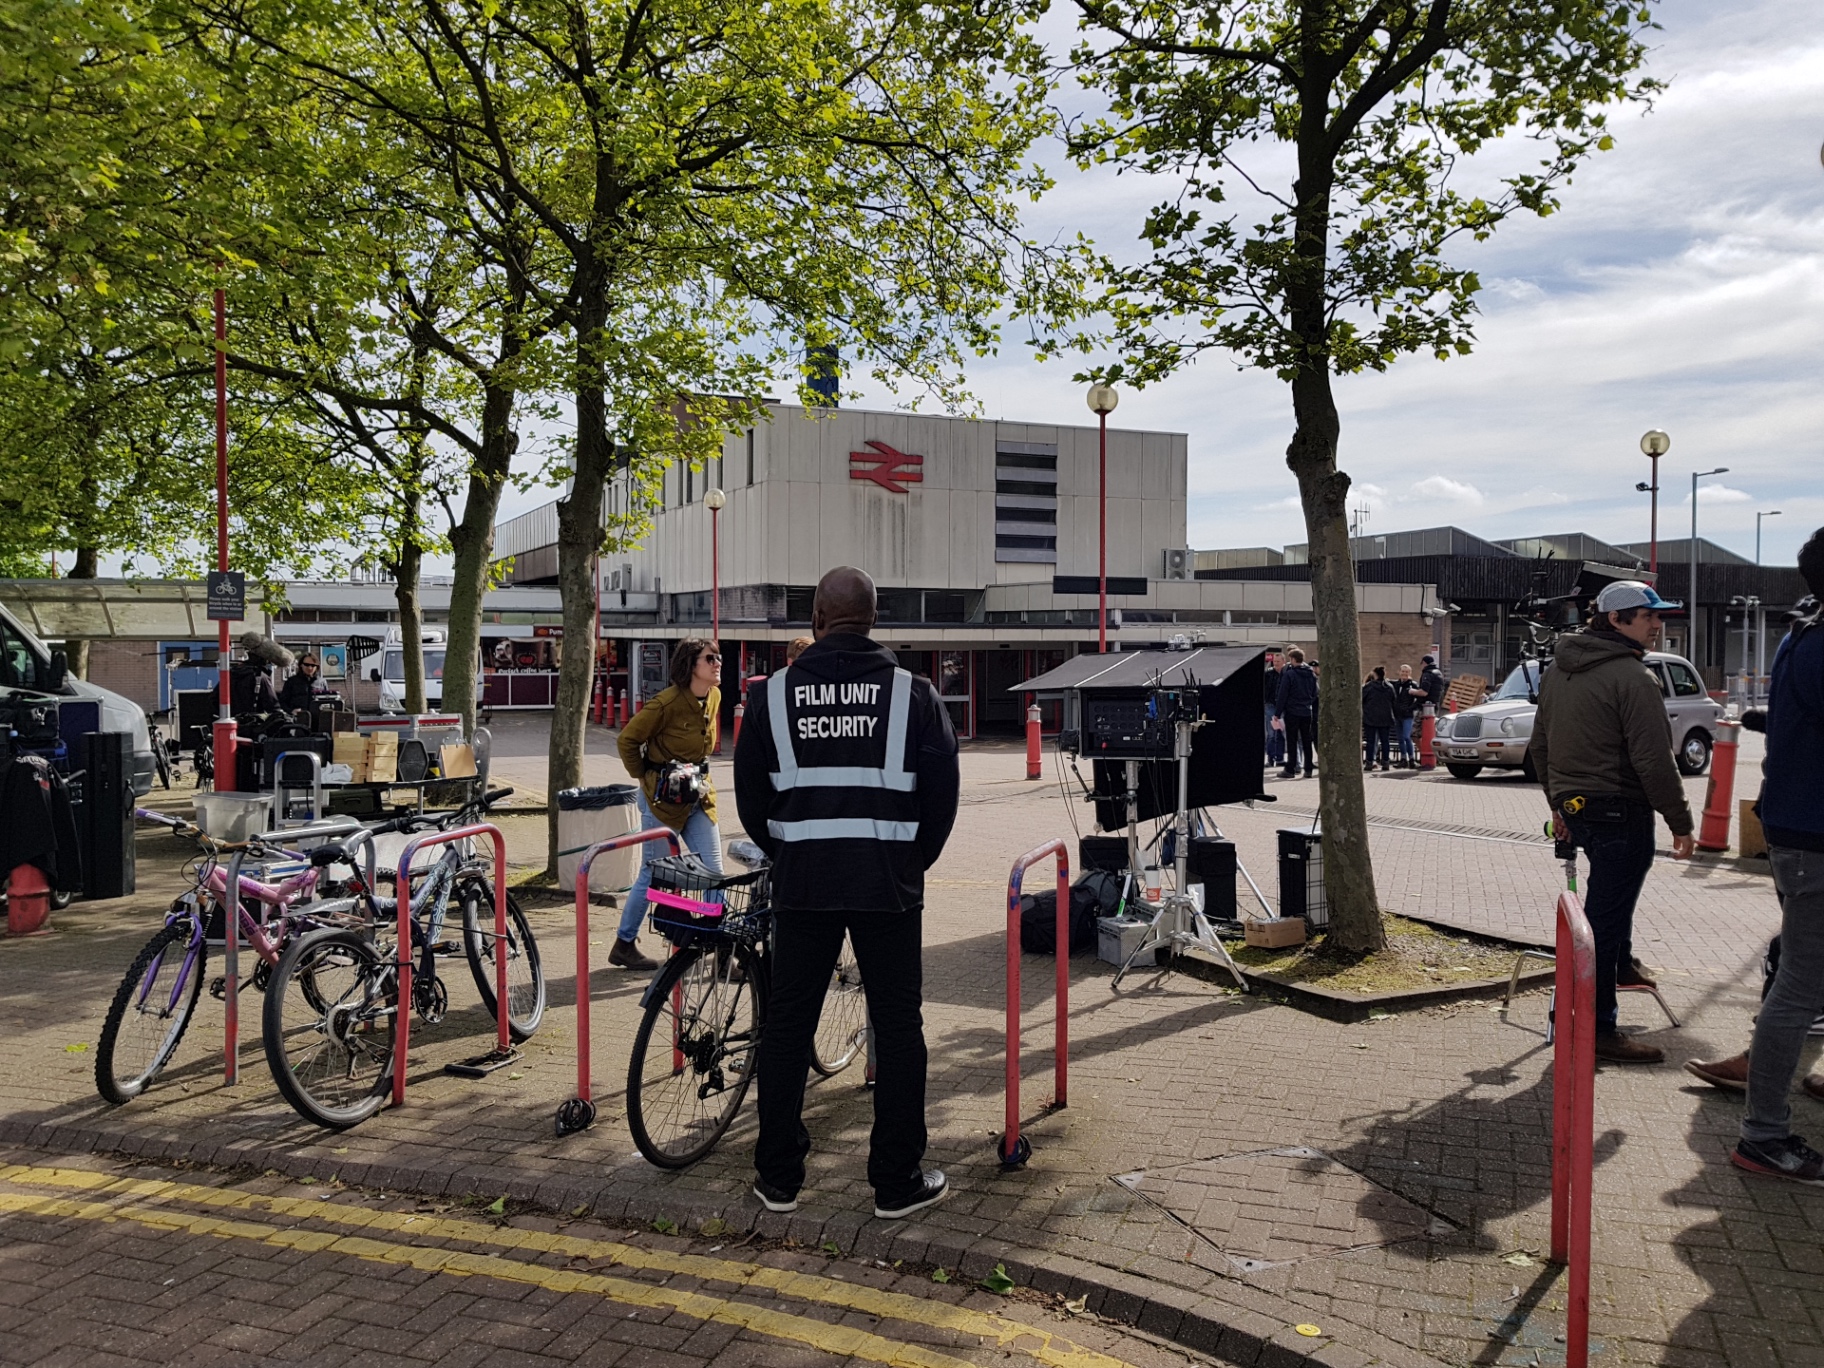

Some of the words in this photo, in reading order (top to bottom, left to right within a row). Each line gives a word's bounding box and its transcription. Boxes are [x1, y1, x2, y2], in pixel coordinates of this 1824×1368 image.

[795, 684, 836, 707] FILM
[840, 683, 880, 705] UNIT
[798, 716, 878, 739] SECURITY
